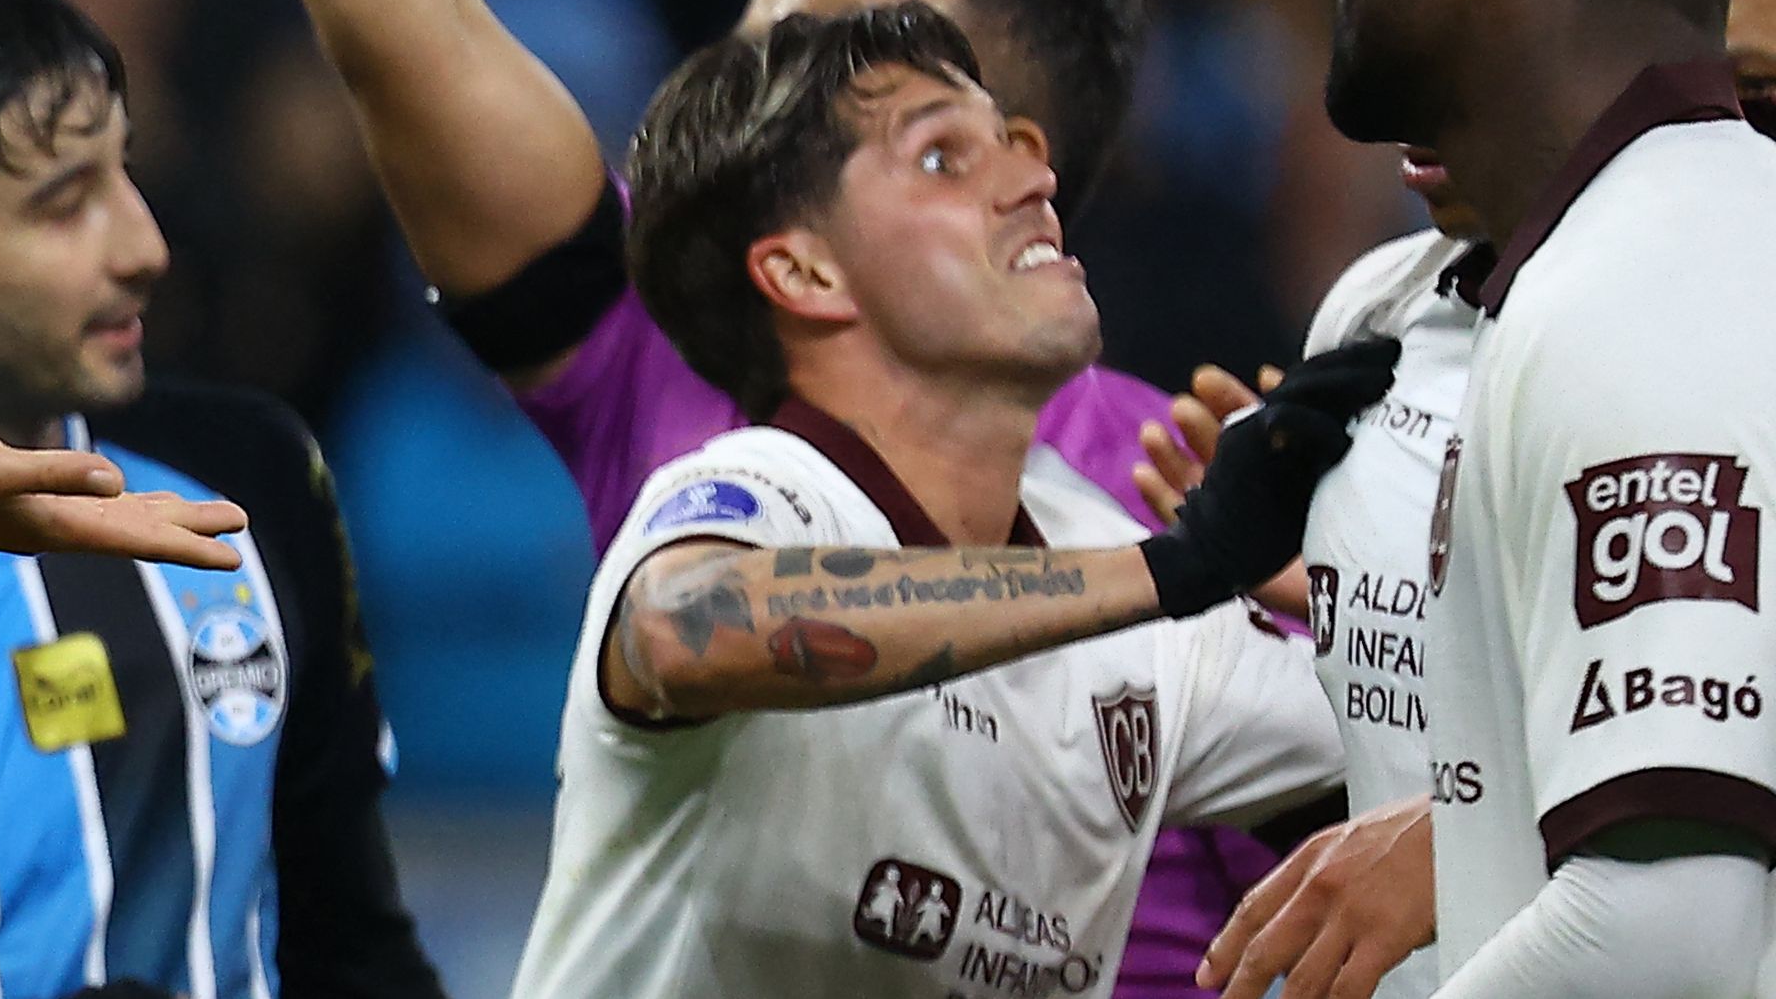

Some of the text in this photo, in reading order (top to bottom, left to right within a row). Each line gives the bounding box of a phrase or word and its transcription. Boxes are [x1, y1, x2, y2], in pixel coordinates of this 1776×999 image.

[1587, 459, 1720, 513] entel
[1592, 507, 1735, 602] gol
[1624, 665, 1763, 722] Bagó
